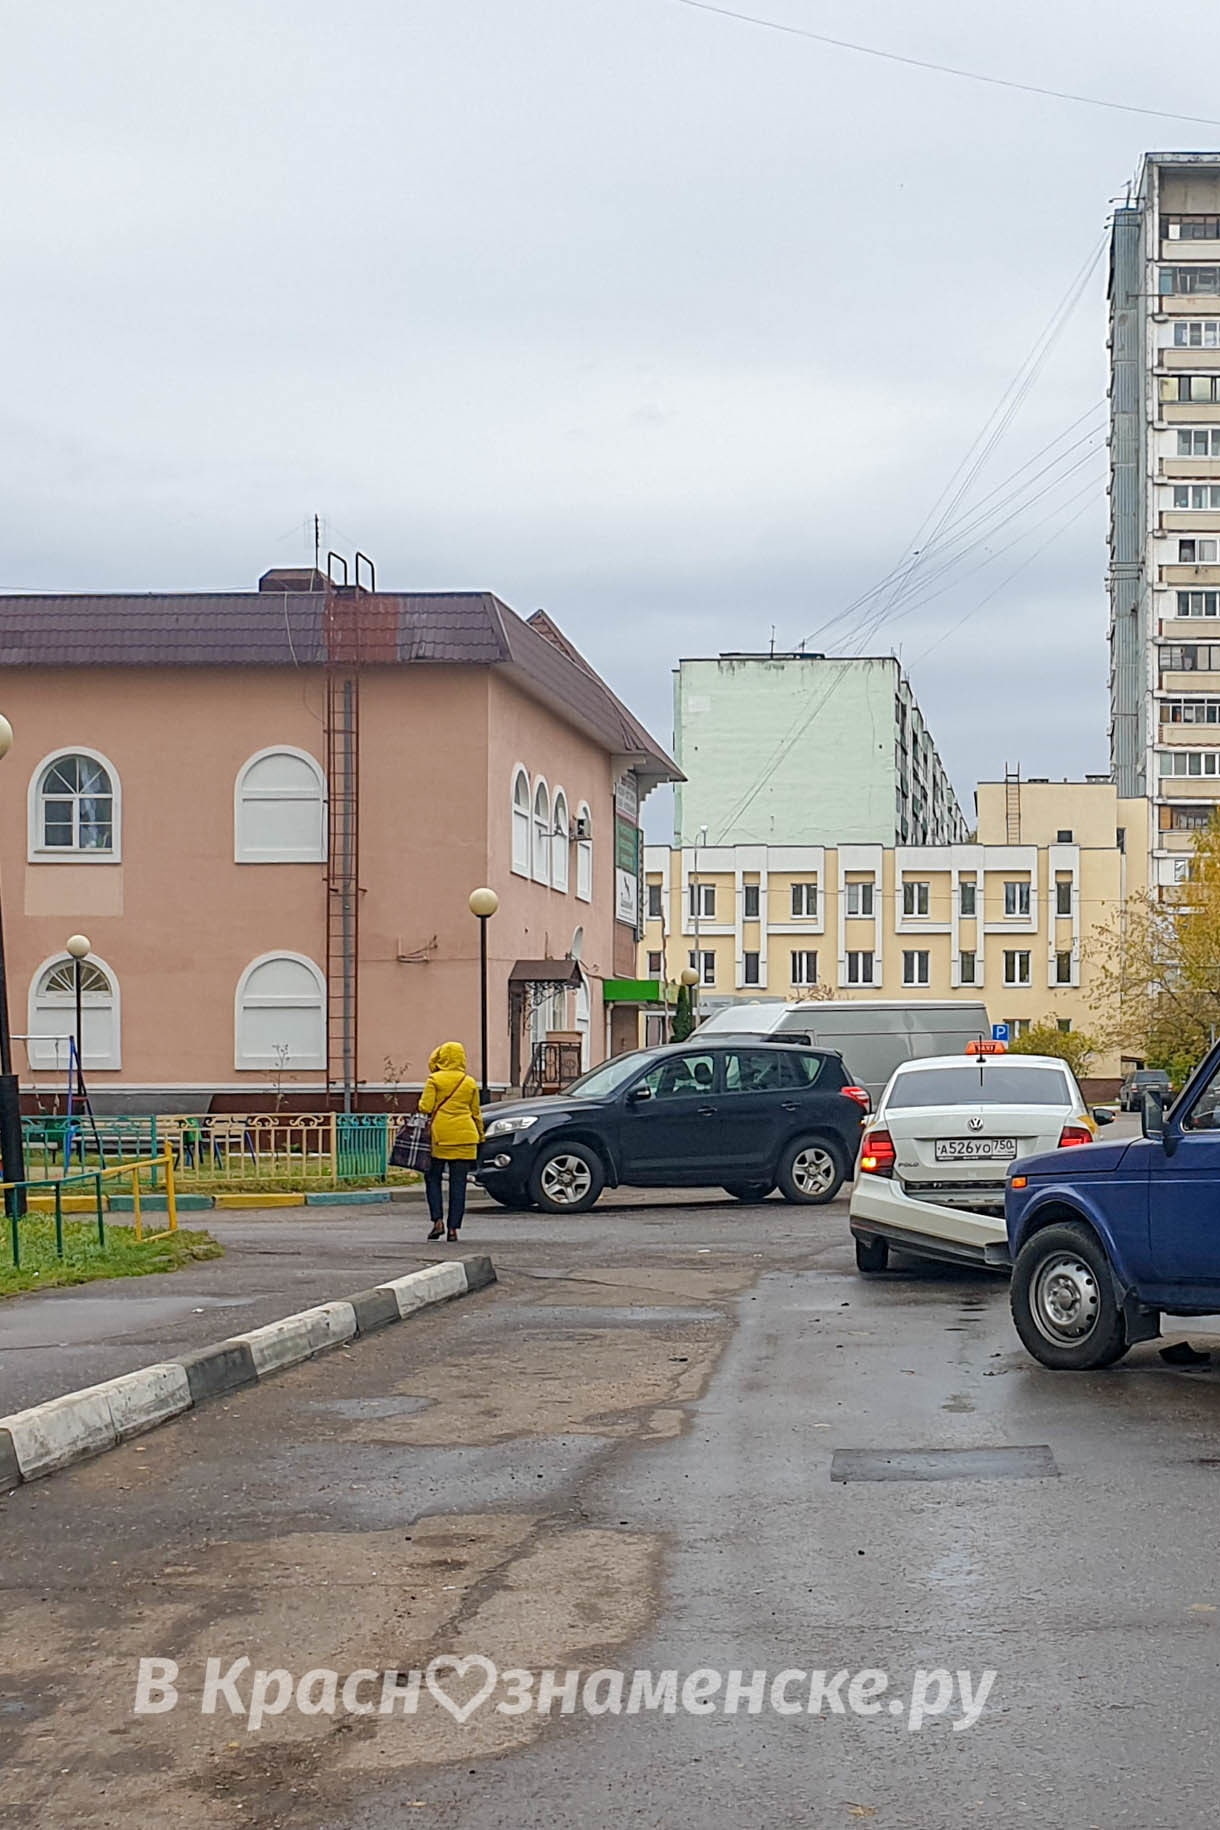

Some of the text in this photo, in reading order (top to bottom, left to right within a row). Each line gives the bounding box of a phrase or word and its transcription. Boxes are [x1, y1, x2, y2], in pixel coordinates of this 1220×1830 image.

[996, 1026, 1006, 1039] P
[940, 1139, 1011, 1154] А526УО 750
